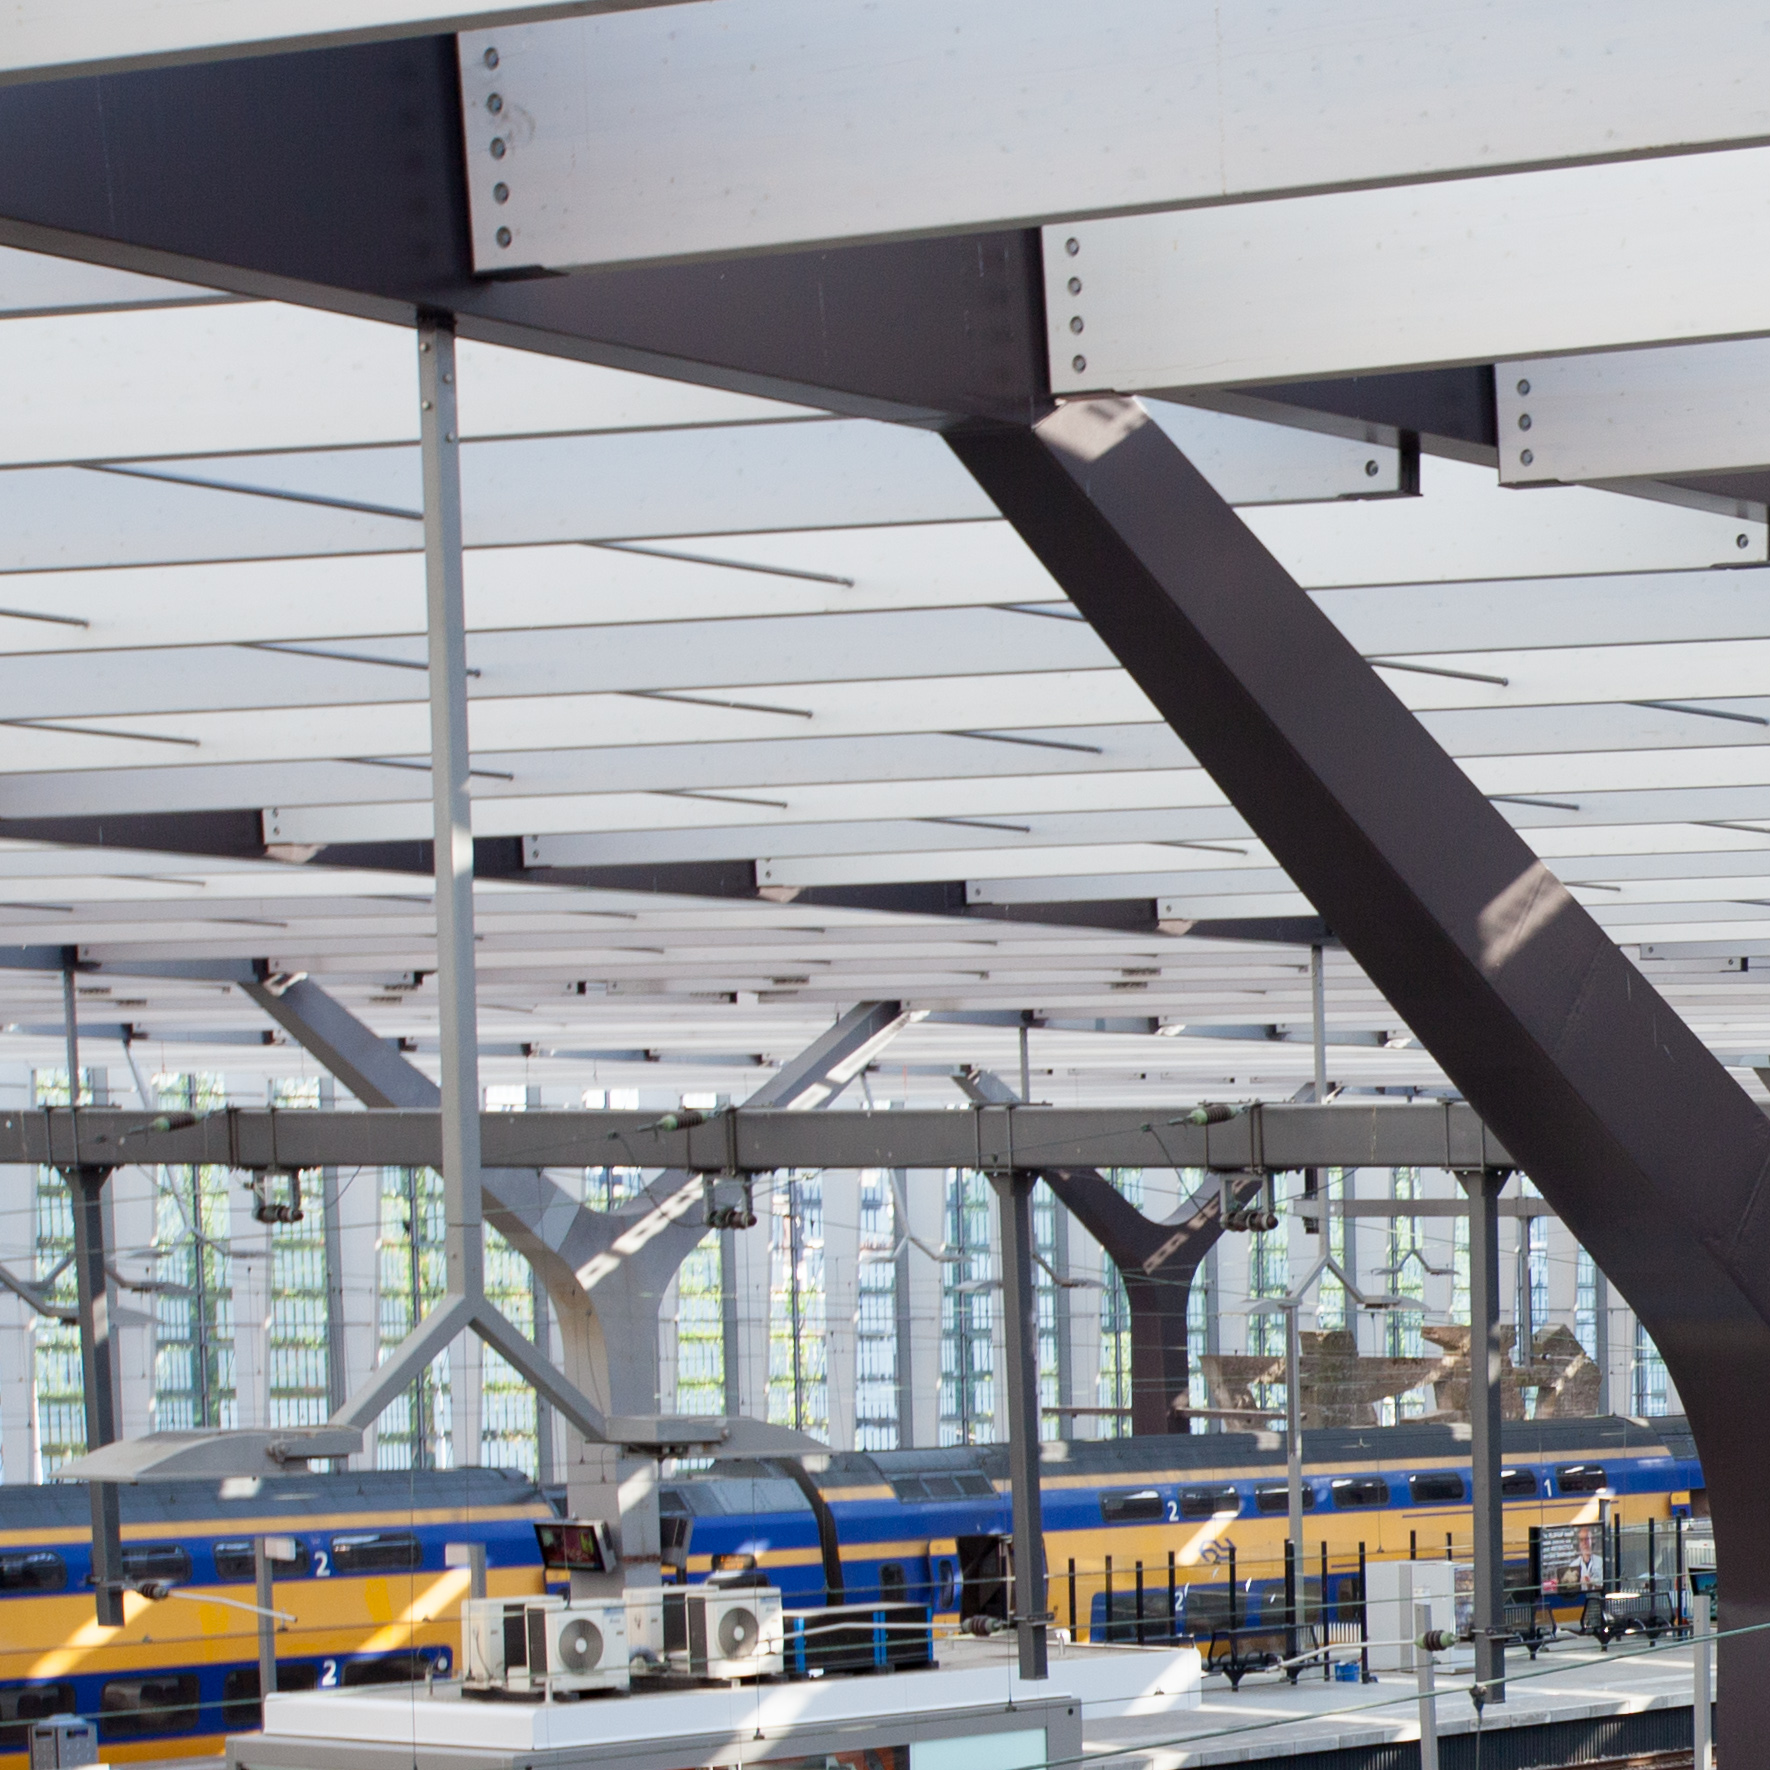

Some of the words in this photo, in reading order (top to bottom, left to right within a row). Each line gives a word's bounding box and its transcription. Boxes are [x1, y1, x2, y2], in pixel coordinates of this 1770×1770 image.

[1543, 1479, 1552, 1498] 1
[1167, 1501, 1179, 1522] 2
[314, 1551, 331, 1577] 2
[1175, 1591, 1183, 1611] 2
[322, 1659, 337, 1686] 2
